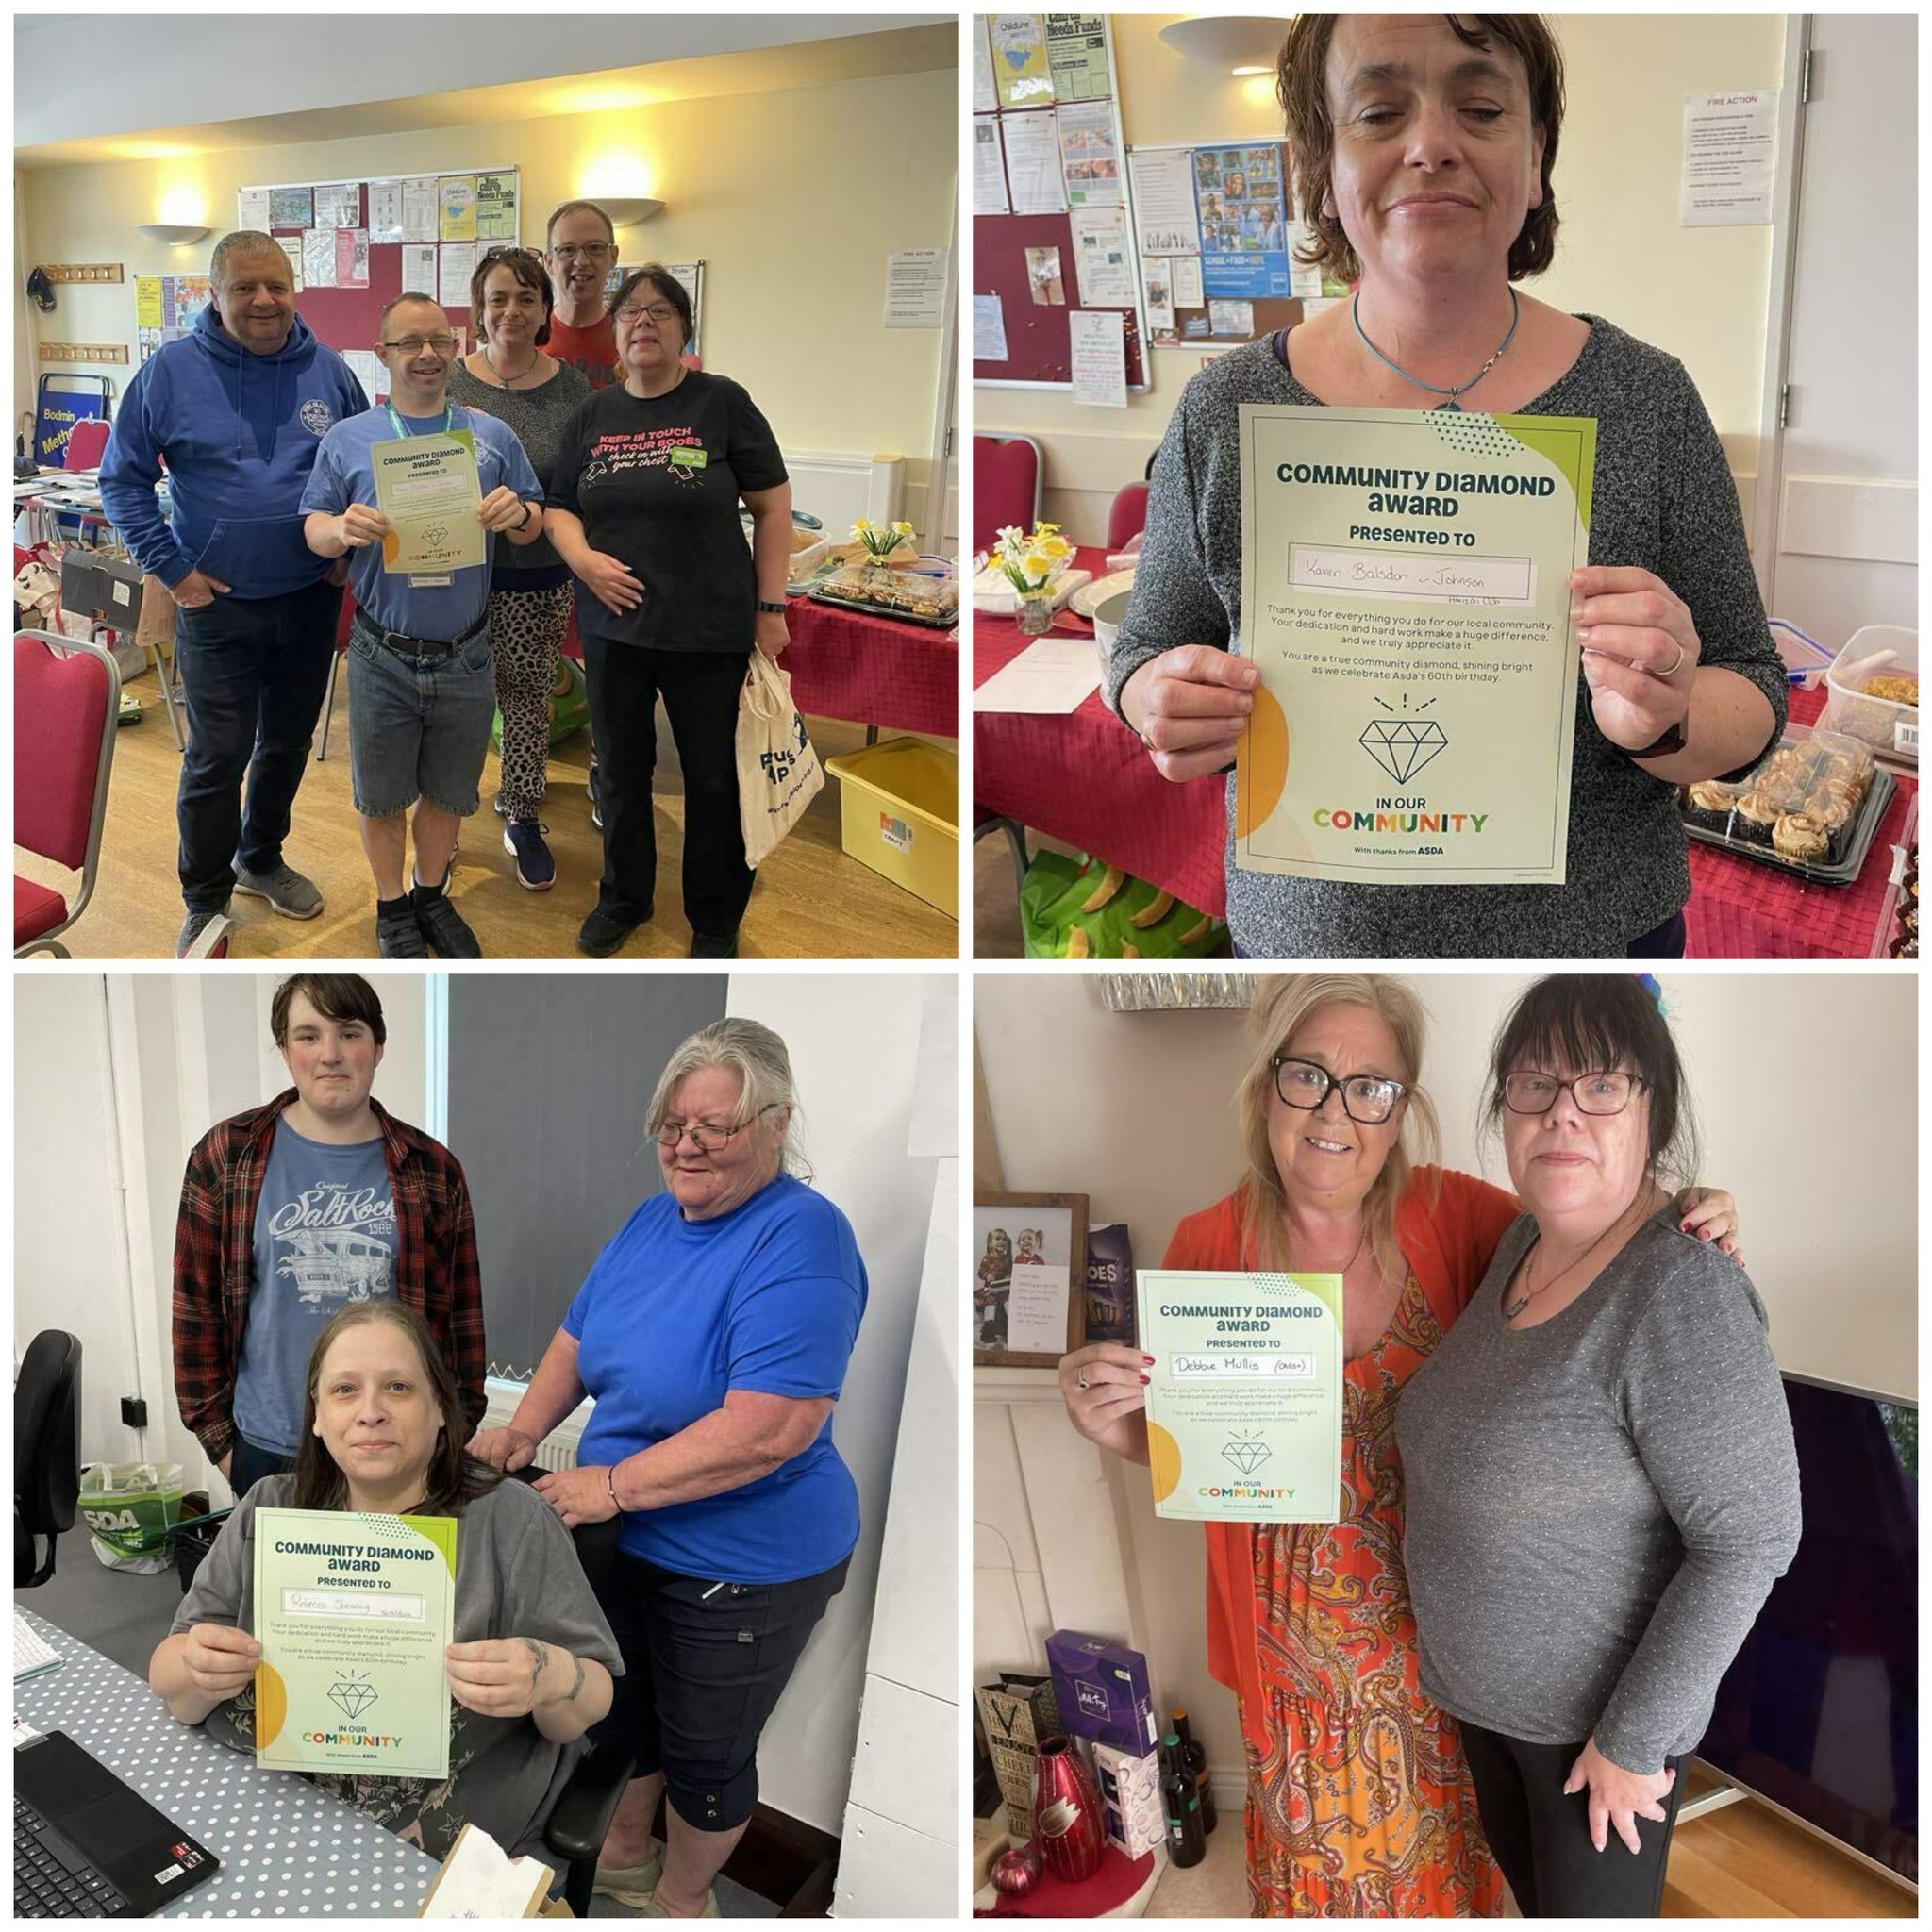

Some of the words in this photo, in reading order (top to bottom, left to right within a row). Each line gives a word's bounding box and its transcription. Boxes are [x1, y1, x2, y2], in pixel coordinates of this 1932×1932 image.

[1047, 23, 1074, 37] Needs
[1074, 19, 1102, 34] Funds
[1707, 97, 1724, 106] FIRE
[1726, 95, 1757, 105] ACTION
[43, 408, 75, 422] Bodmin
[599, 435, 631, 444] KEEP
[633, 432, 646, 441] IN
[649, 427, 691, 440] TOUCH
[591, 443, 620, 458] WITH
[622, 441, 655, 451] YOUR
[657, 437, 703, 447] BOOBS
[608, 451, 637, 462] check
[612, 461, 636, 474] your
[638, 455, 669, 466] chest
[1453, 533, 1475, 546] TO
[1268, 605, 1295, 614] Thank
[1318, 608, 1331, 618] for
[1335, 611, 1391, 625] everything
[1392, 616, 1411, 625] you
[1429, 618, 1444, 626] for
[1467, 620, 1491, 628] local
[1492, 620, 1555, 631] community.
[1271, 617, 1293, 626] Your
[1295, 619, 1349, 631] dedication
[1372, 625, 1395, 636] hard
[1397, 628, 1423, 637] work
[1424, 629, 1453, 638] make
[1463, 630, 1489, 640] huge
[1491, 631, 1549, 641] difference,
[1341, 636, 1360, 644] and
[1378, 639, 1404, 650] truly
[1405, 641, 1462, 650] appreciate
[1282, 650, 1301, 660] You
[1303, 653, 1319, 661] are
[1329, 655, 1350, 664] true
[1353, 657, 1409, 670] community
[1413, 661, 1461, 670] diamond,
[1462, 662, 1499, 672] shining
[1501, 663, 1533, 673] bright
[1341, 668, 1391, 679] celebrate
[1392, 672, 1425, 680] Asda's
[1427, 672, 1453, 680] 60th
[1455, 673, 1501, 683] birthday.
[1376, 798, 1391, 808] IN
[1394, 797, 1426, 809] OUR
[1312, 808, 1489, 833] COMMUNITY
[1418, 846, 1444, 856] ASDA
[1268, 1340, 1281, 1348] TO
[1198, 1487, 1296, 1498] COMMUNITY
[377, 1580, 391, 1589] TO
[302, 1732, 403, 1748] COMMUNITY
